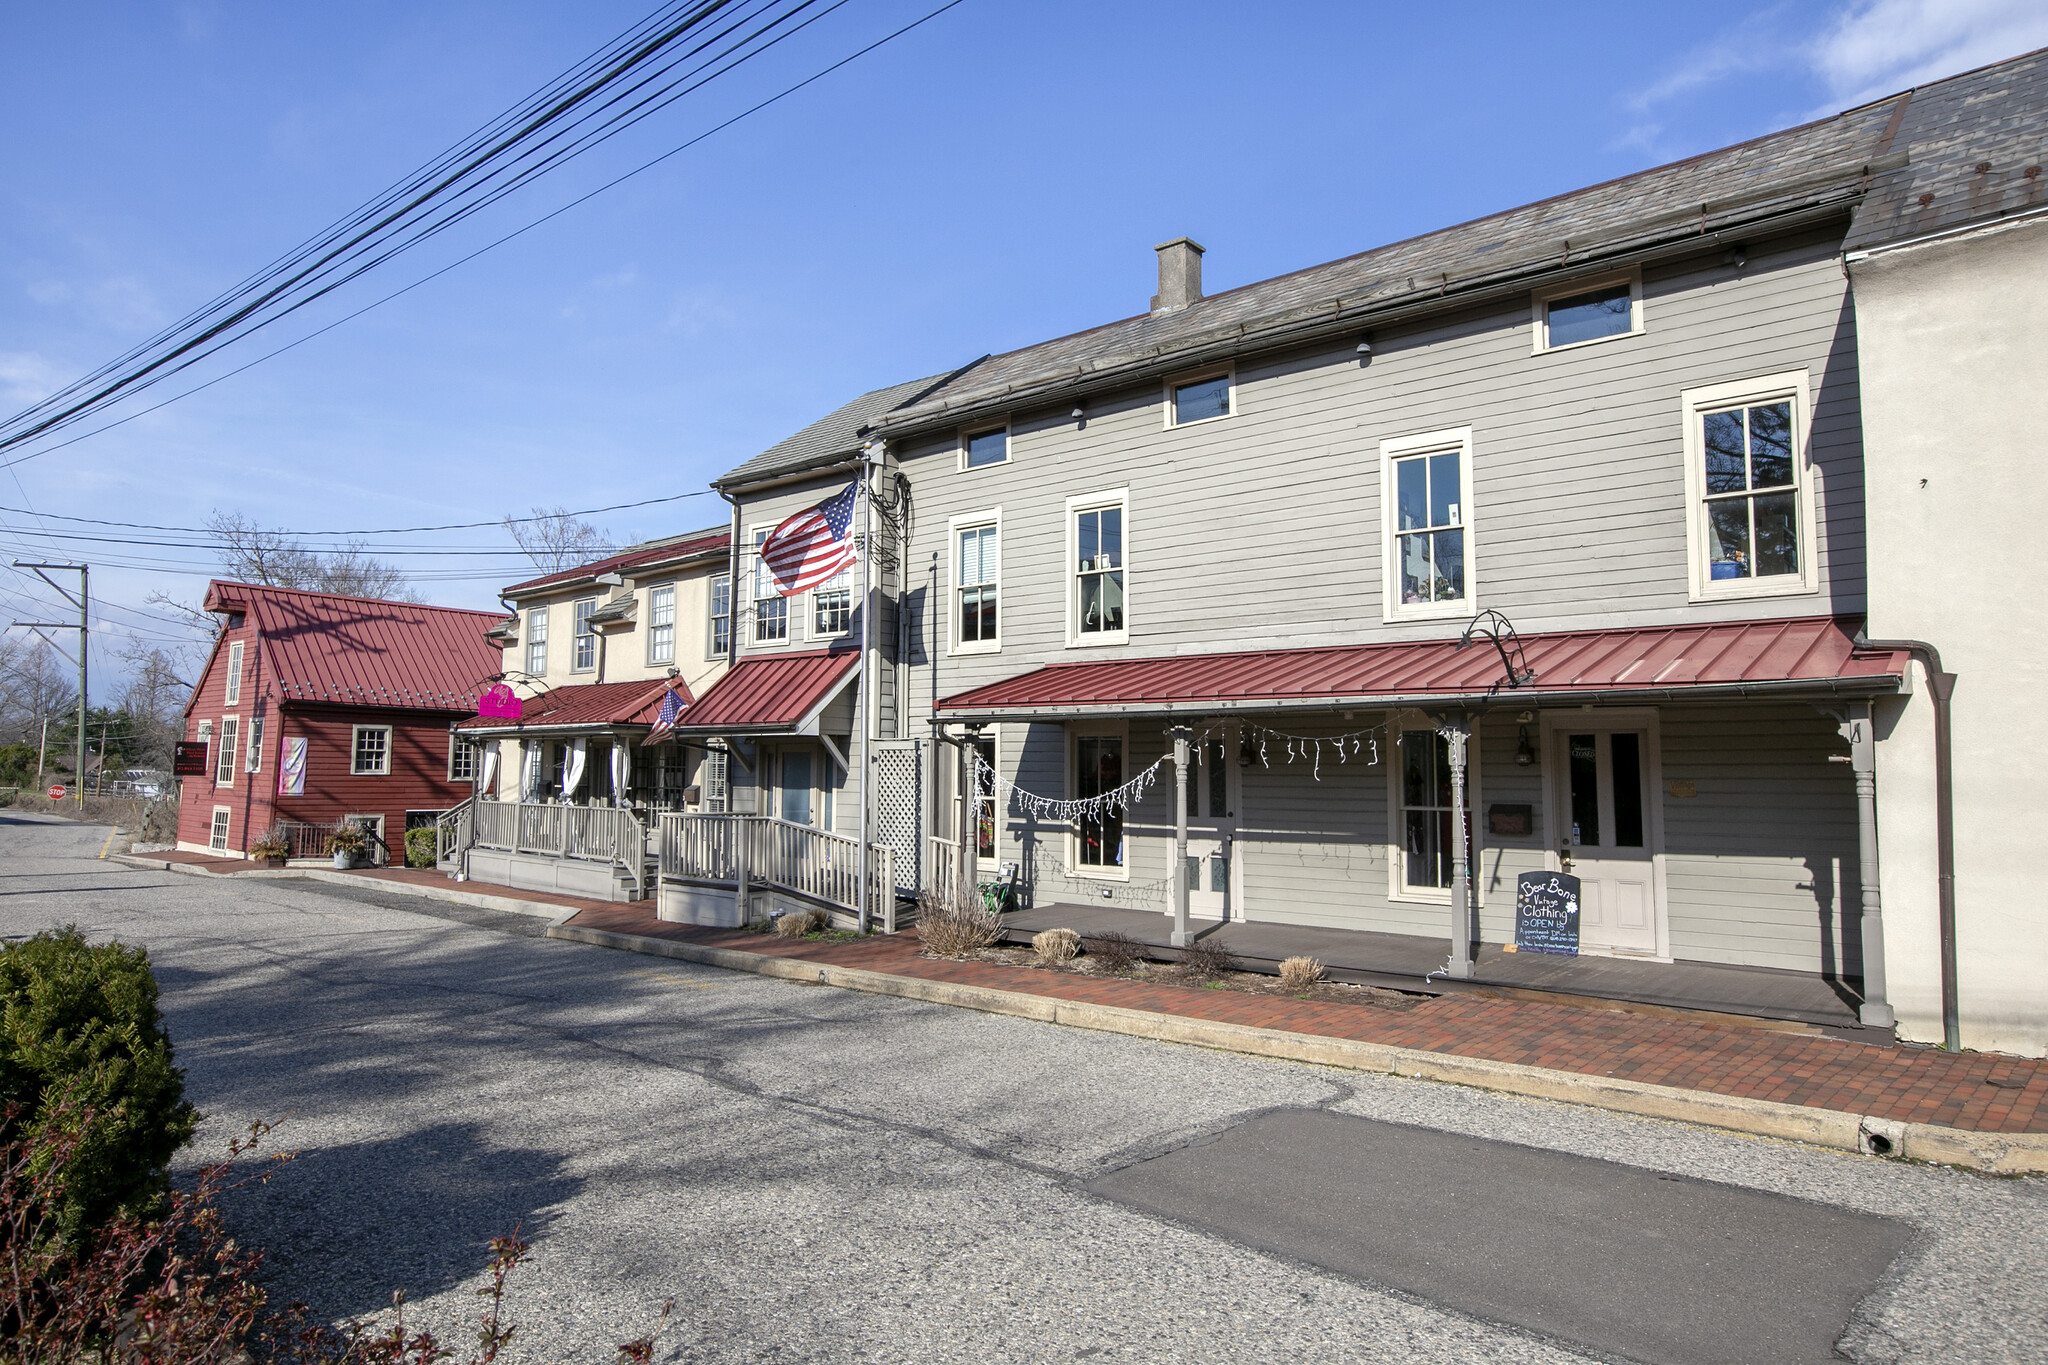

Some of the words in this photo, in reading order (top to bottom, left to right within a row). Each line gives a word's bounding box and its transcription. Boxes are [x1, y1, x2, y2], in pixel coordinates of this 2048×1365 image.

[485, 698, 518, 706] STUDIO
[1520, 882, 1546, 897] Bear
[1547, 878, 1576, 901] Bone
[1534, 894, 1558, 908] Vintage
[1522, 904, 1568, 925] Clothing
[1530, 918, 1554, 928] OPEN
